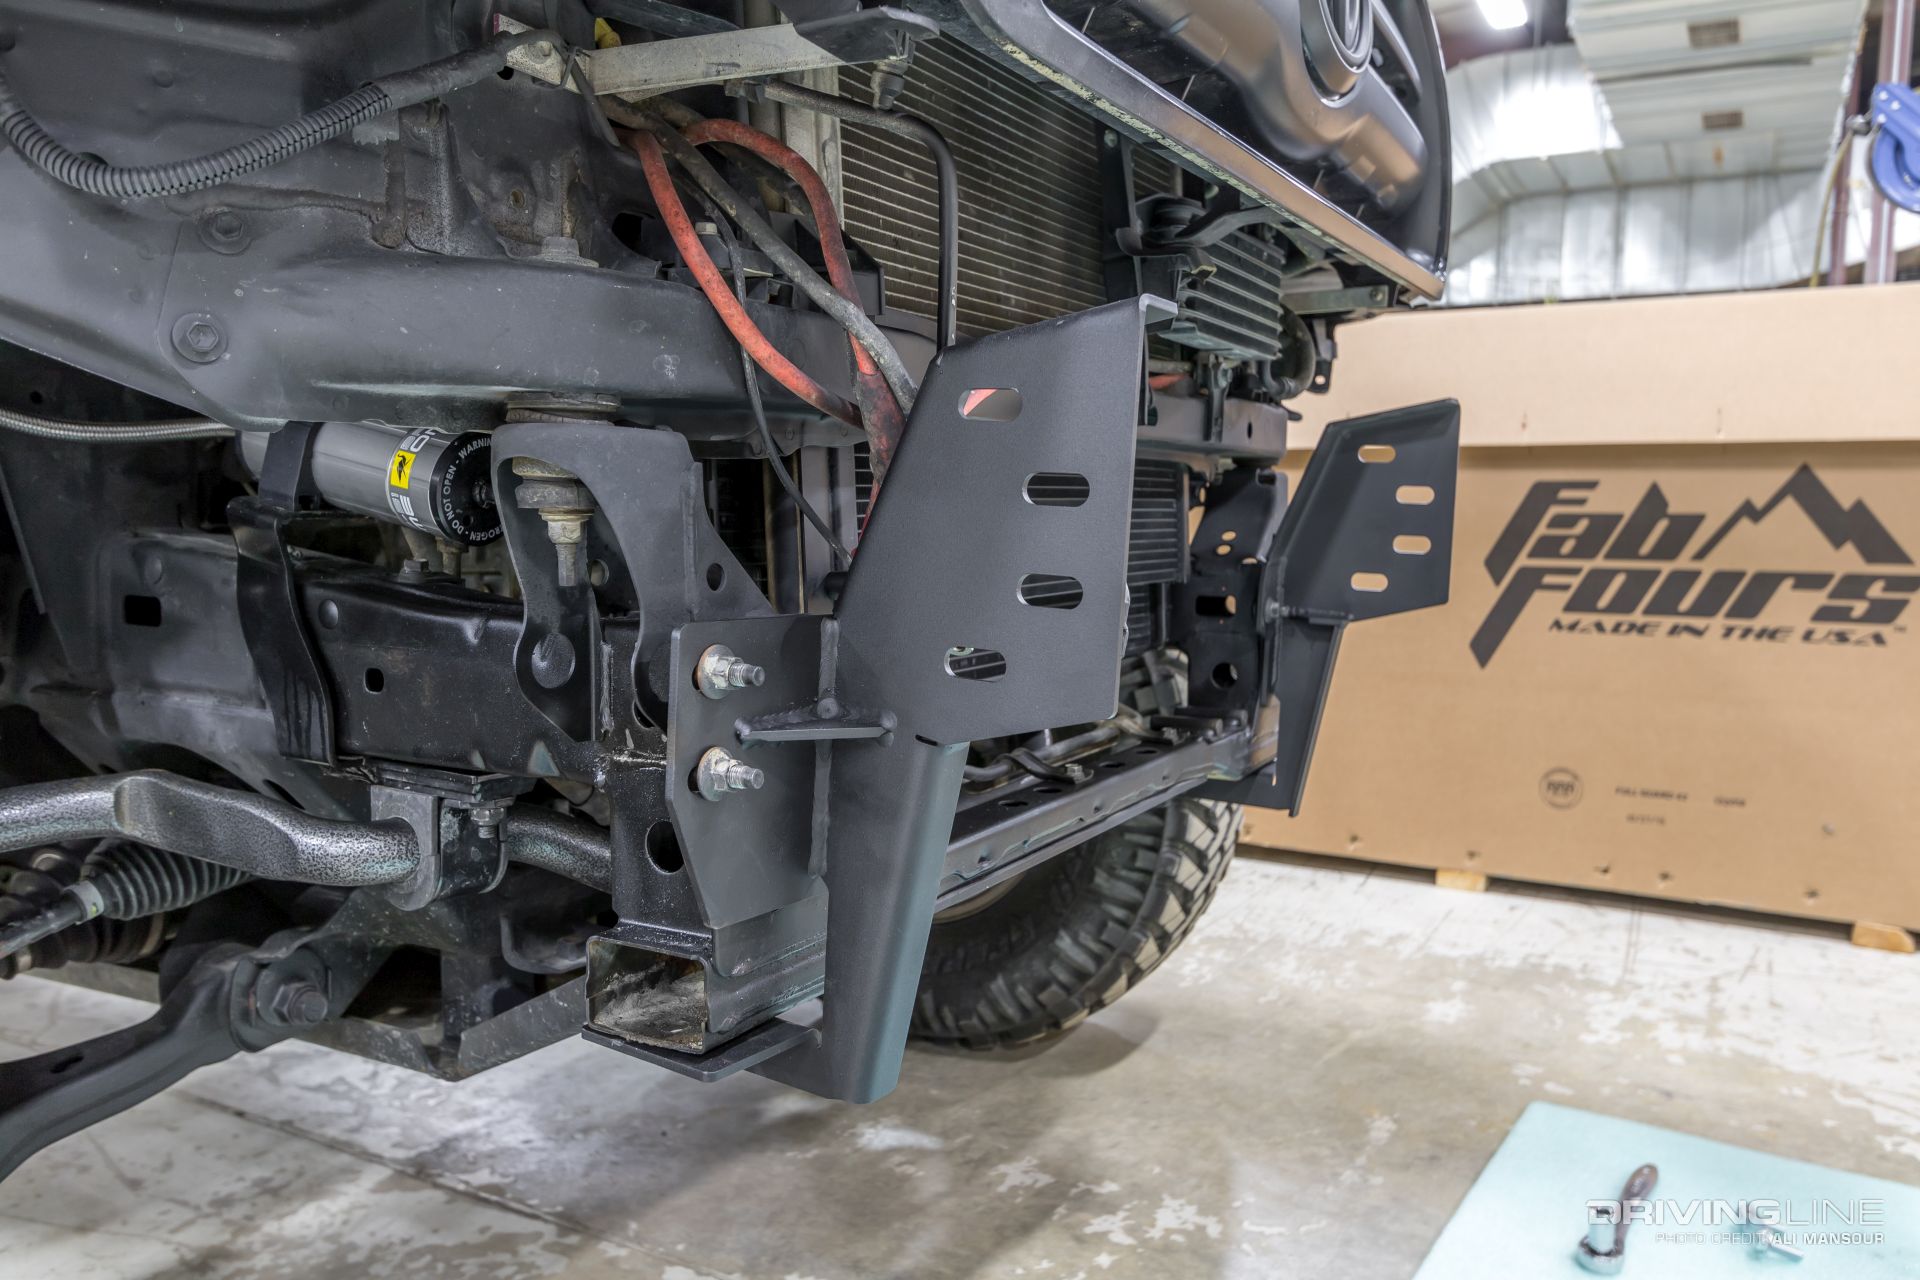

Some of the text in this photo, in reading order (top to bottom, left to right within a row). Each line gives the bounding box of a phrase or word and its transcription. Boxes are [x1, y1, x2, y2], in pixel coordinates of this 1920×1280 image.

[458, 437, 492, 460] WARNIN
[443, 465, 456, 495] OPEN
[443, 497, 454, 520] NOT
[452, 520, 464, 534] DO
[1484, 480, 1706, 587] Fab
[1469, 566, 1920, 670] Fours
[1549, 617, 1662, 637] MADE
[1667, 622, 1709, 638] IN
[1722, 624, 1794, 643] THE
[1801, 627, 1888, 647] USA
